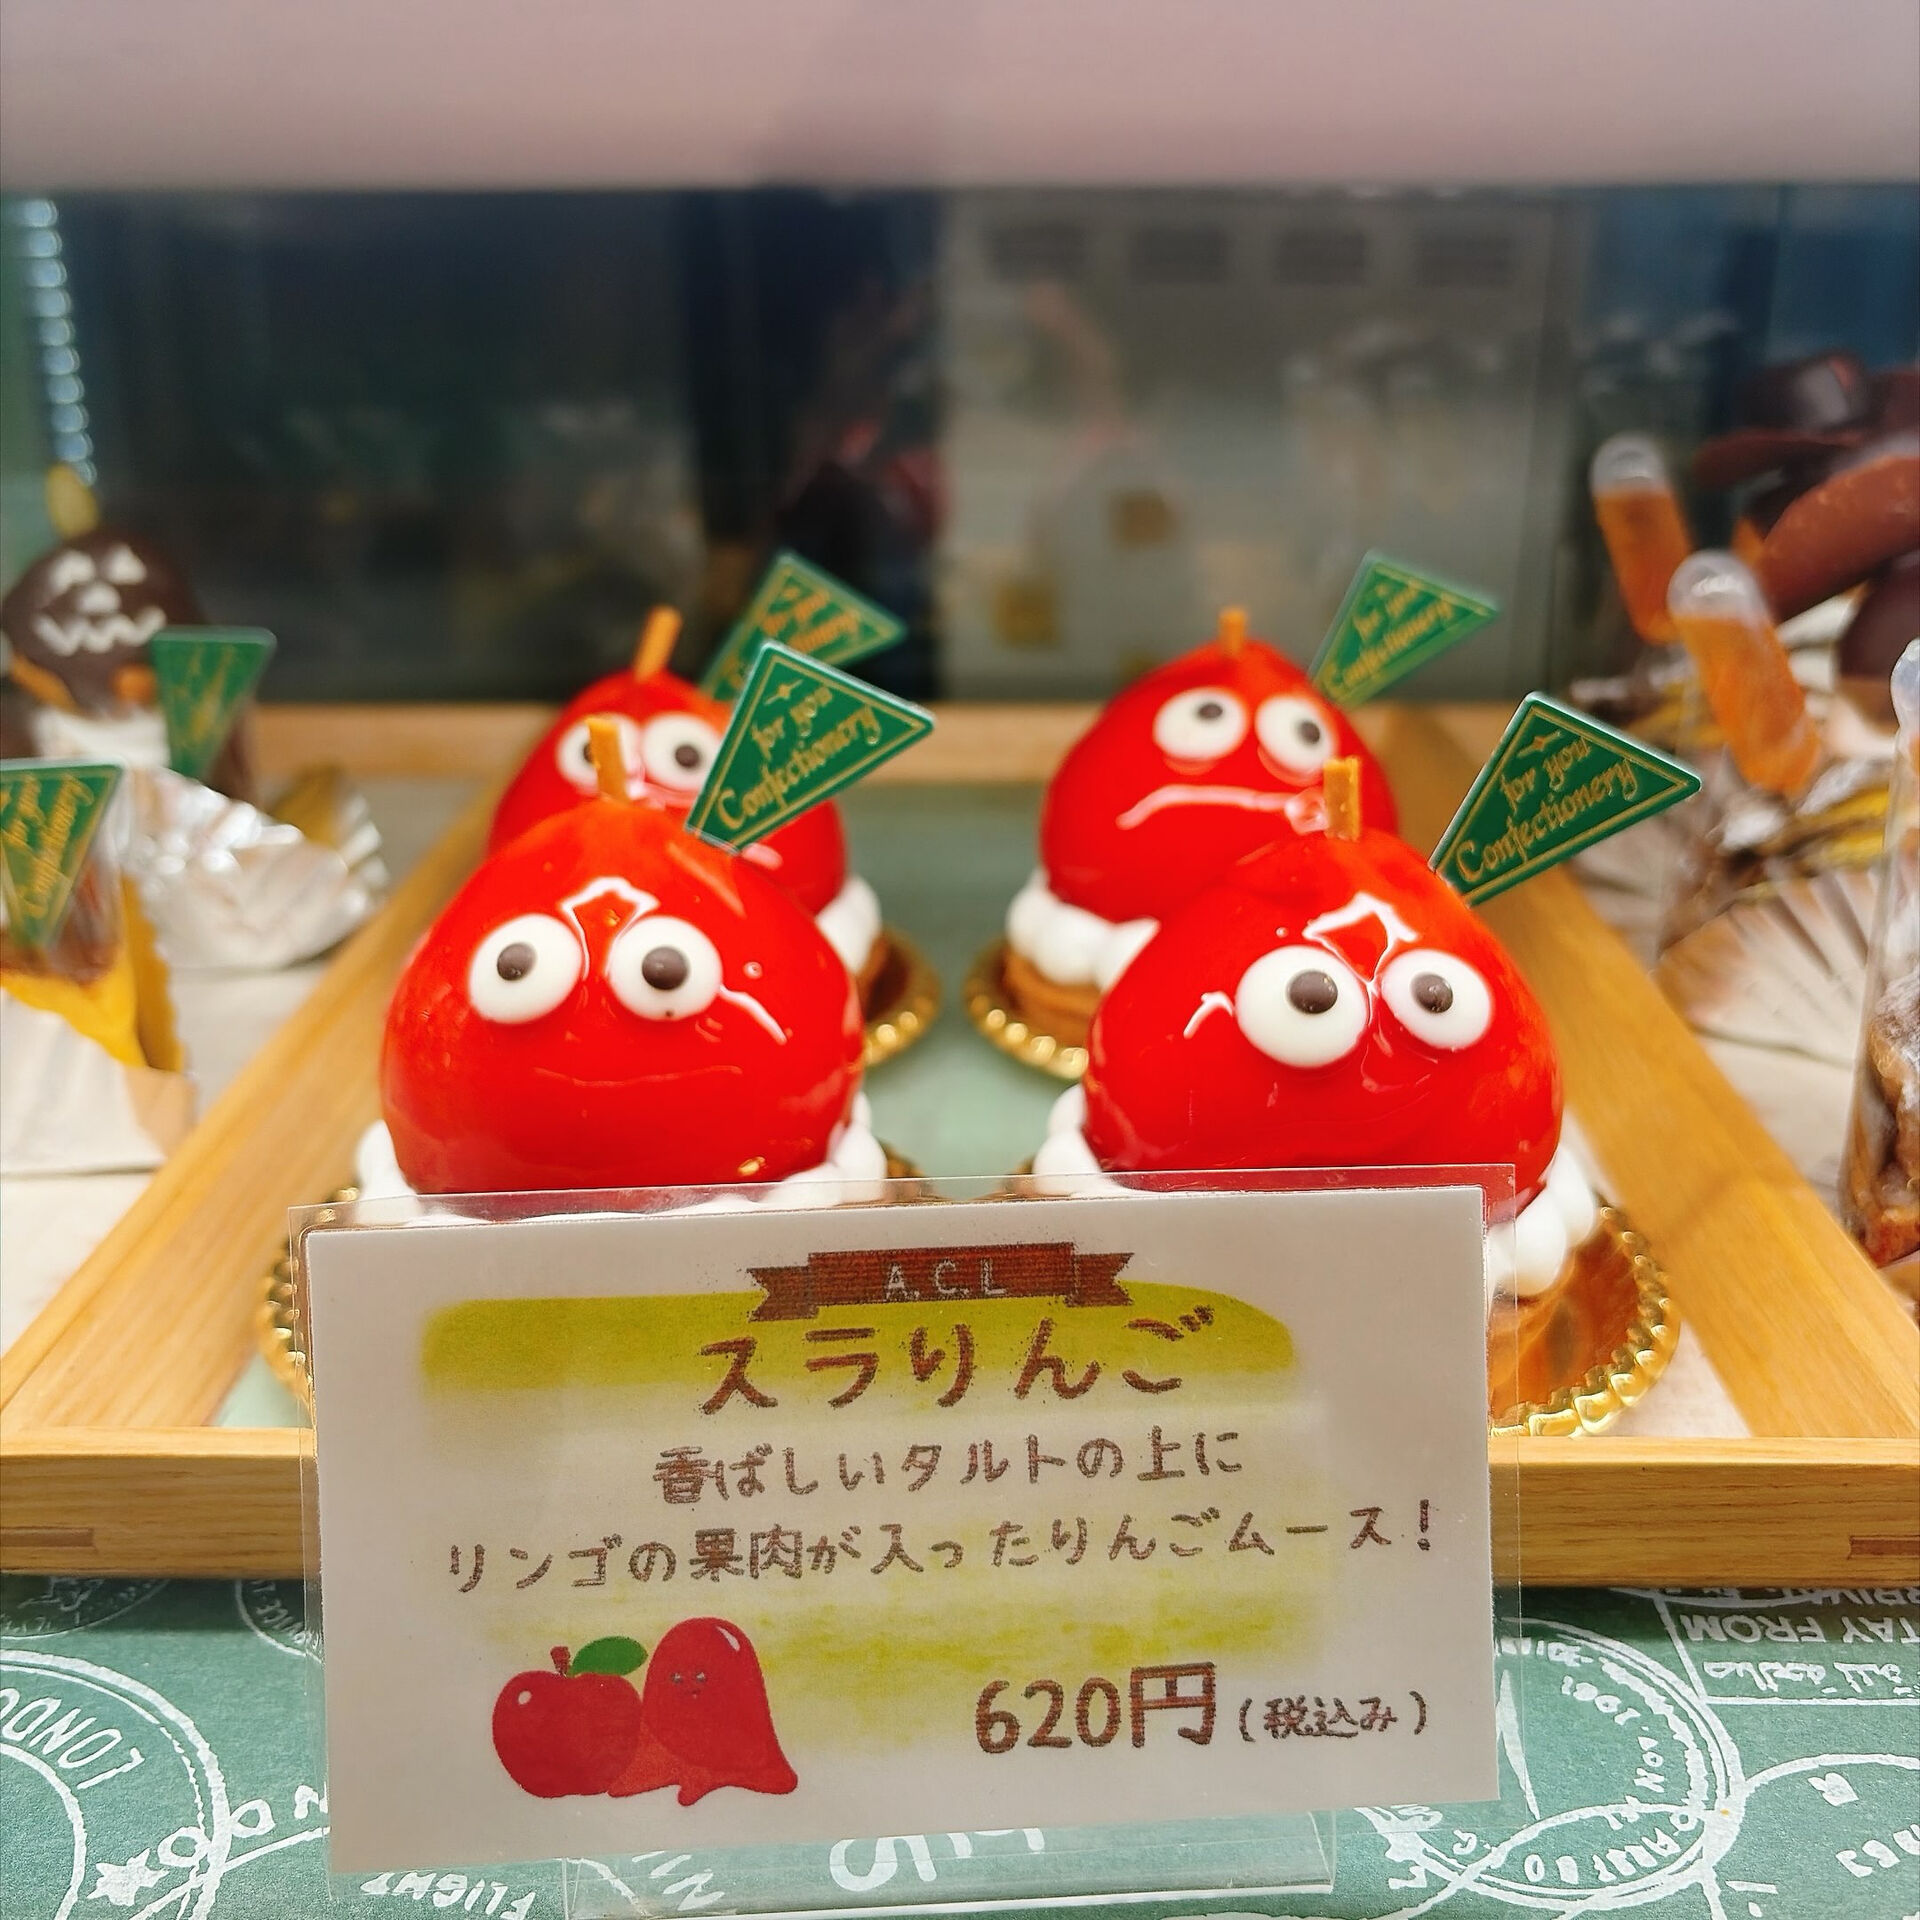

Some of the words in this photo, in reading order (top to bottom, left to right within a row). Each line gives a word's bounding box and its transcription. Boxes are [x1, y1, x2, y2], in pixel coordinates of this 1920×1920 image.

[1499, 773, 1537, 812] for
[1542, 736, 1592, 792] you
[1456, 758, 1640, 884] Confectionery
[698, 1304, 1216, 1417] スラりんご
[652, 1424, 1244, 1505] 香ばしいタルトの上に
[1680, 1613, 1827, 1644] FROM
[974, 1660, 1218, 1755] 620円
